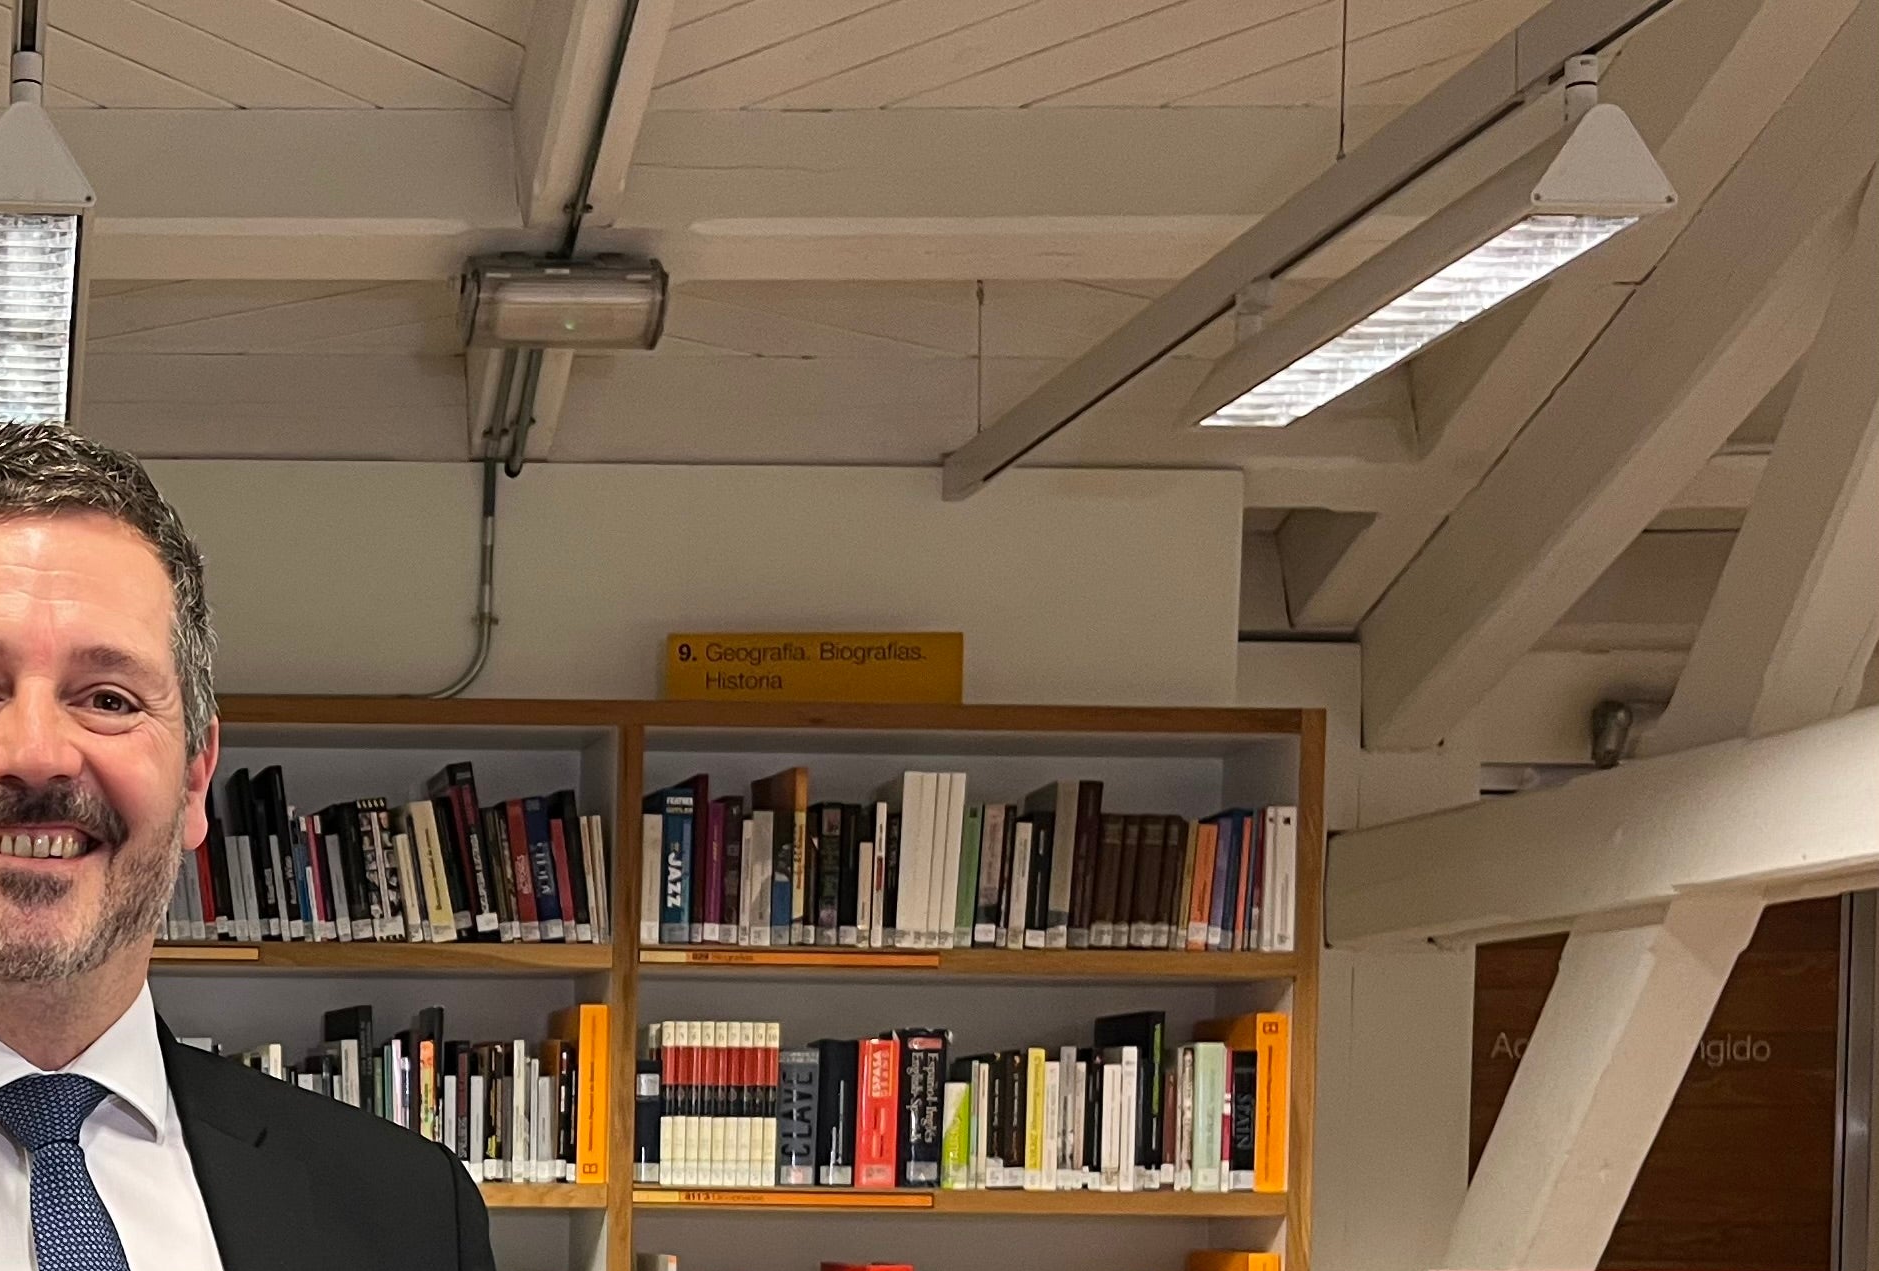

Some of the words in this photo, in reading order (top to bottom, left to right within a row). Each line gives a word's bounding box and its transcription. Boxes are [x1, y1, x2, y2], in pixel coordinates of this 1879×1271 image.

[679, 644, 697, 662] 9.
[706, 672, 782, 690] Historia
[667, 852, 682, 909] JAZZ
[781, 1071, 812, 1158] CLAVE
